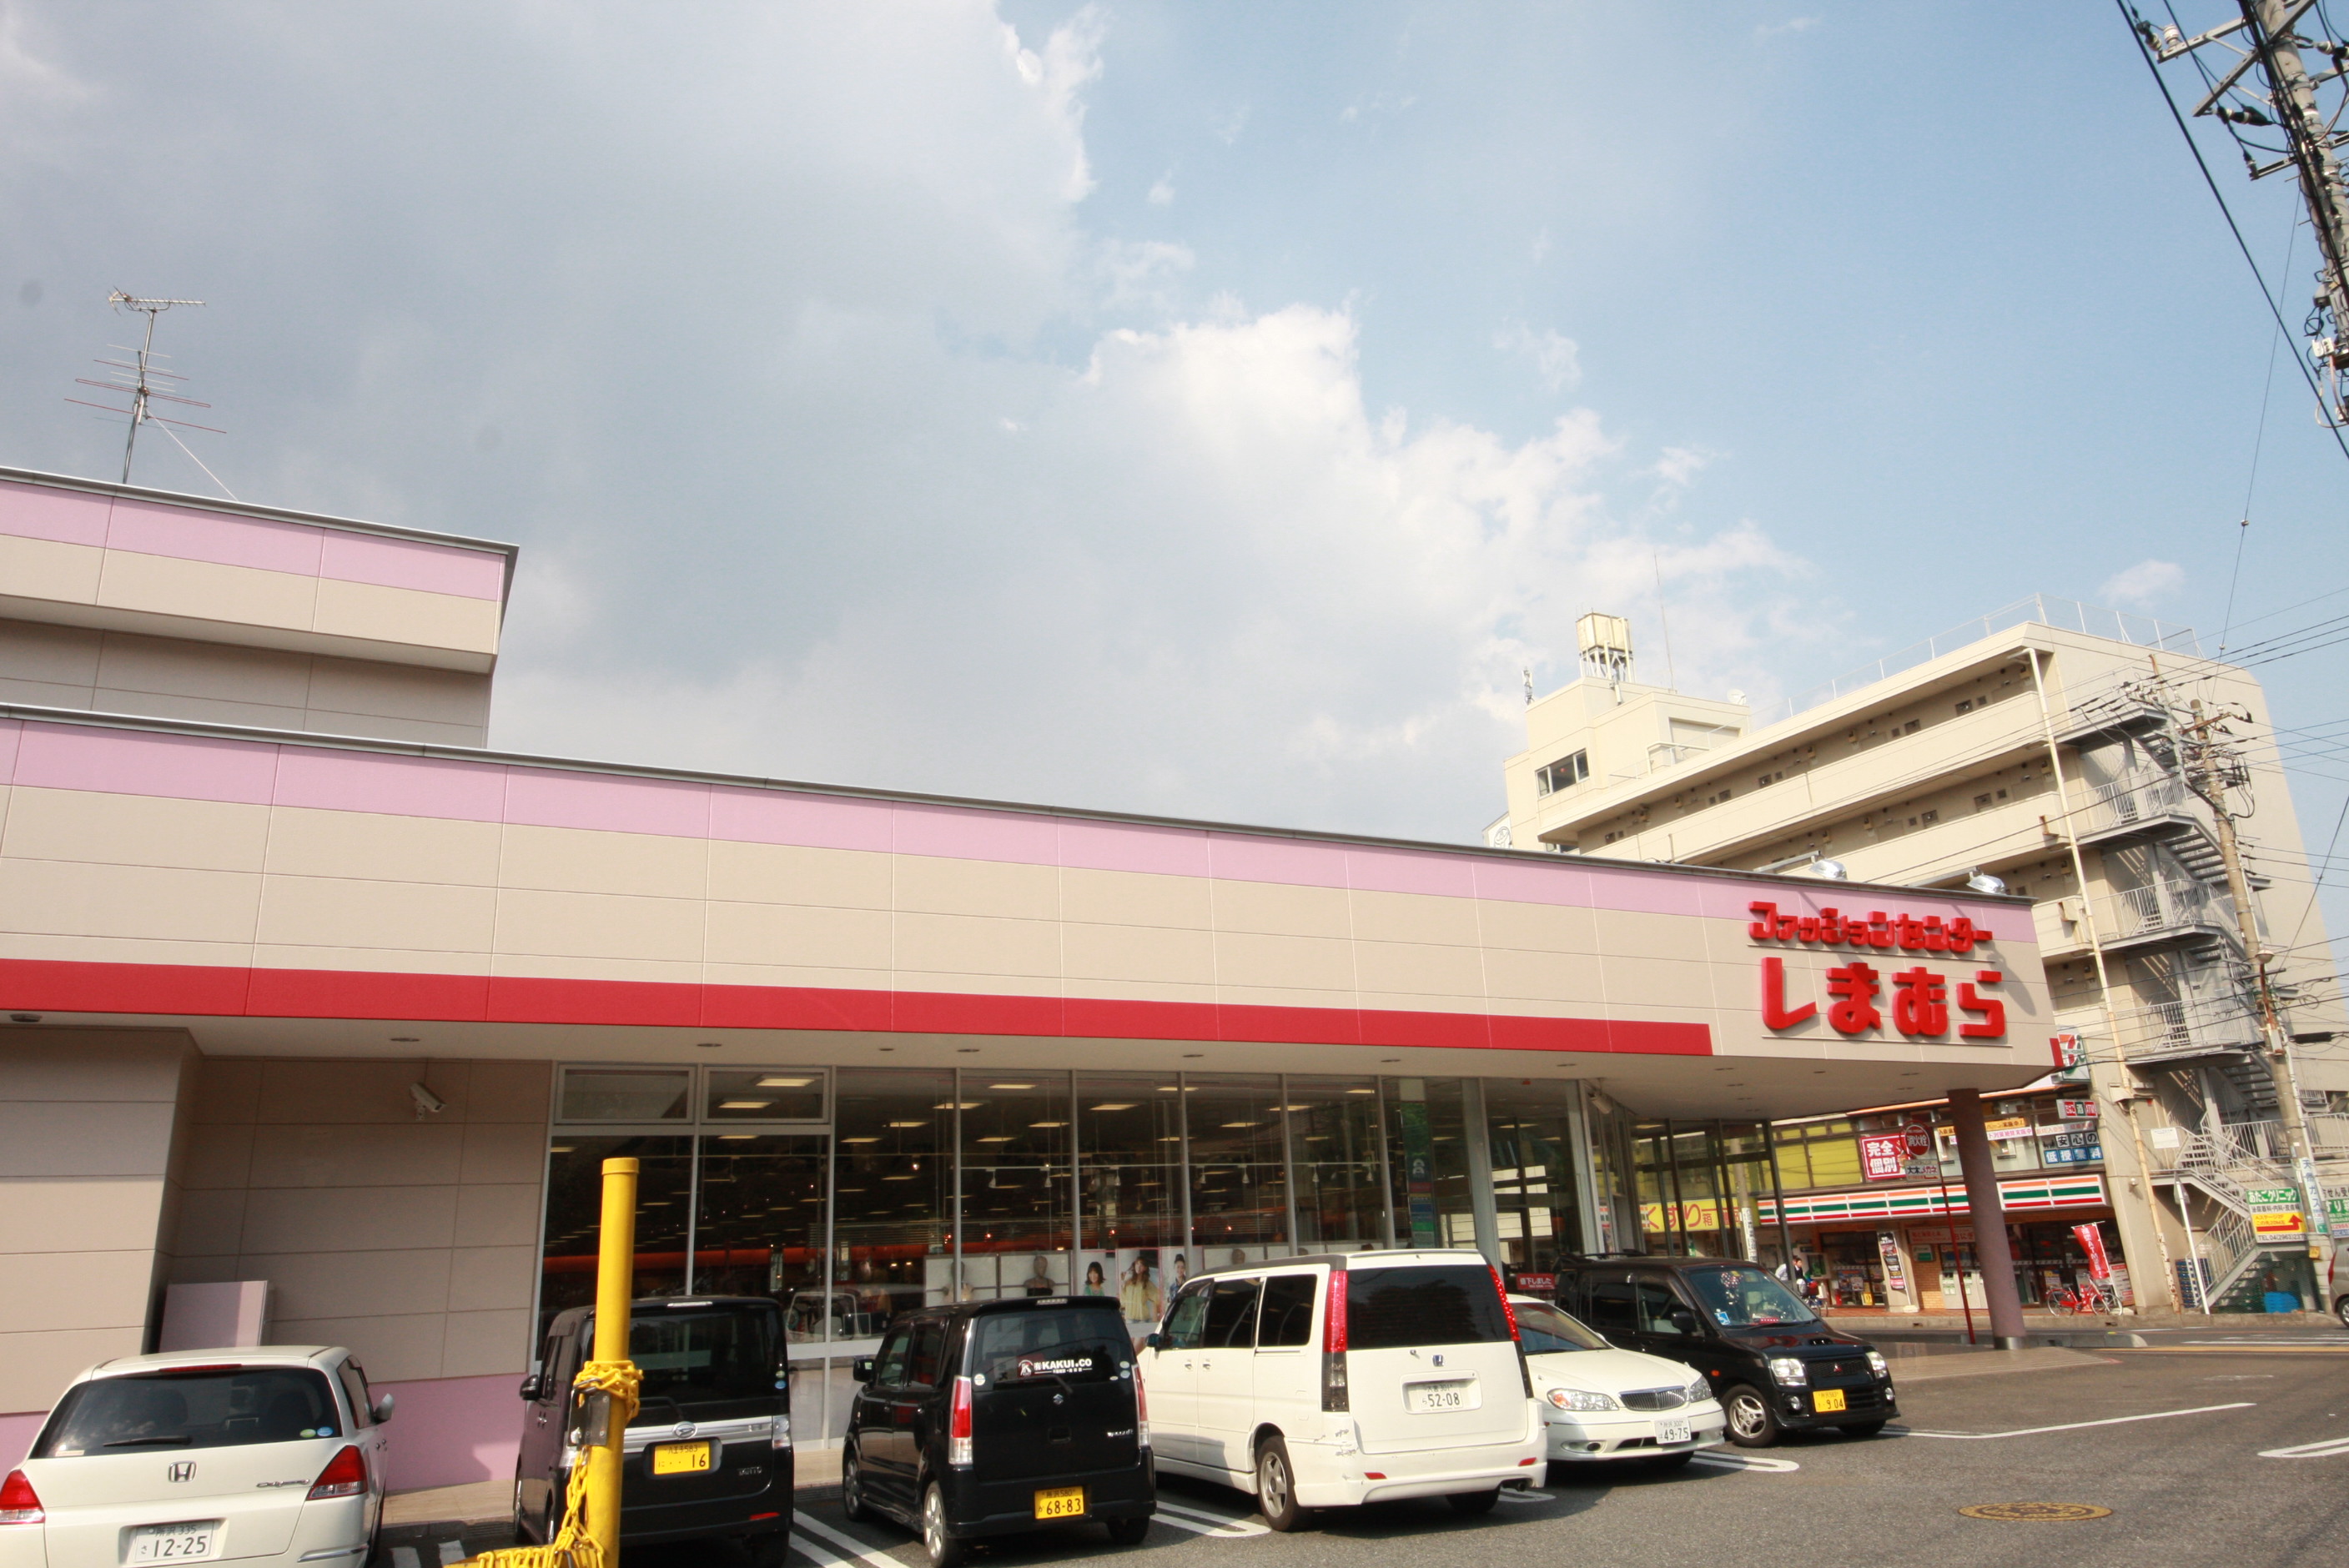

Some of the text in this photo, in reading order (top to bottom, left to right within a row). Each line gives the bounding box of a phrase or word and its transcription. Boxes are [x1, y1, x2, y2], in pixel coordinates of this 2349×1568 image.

[1748, 901, 1993, 952] ファッションセンター
[1761, 957, 2005, 1038] しまむら
[1907, 1134, 1928, 1147] 消火栓
[2057, 1133, 2097, 1146] 安心の
[1867, 1140, 1894, 1158] 完全
[2046, 1147, 2101, 1163] 低授業料
[1869, 1157, 1898, 1174] 個別
[2248, 1188, 2297, 1203] あたごクリニック
[1427, 1392, 1461, 1407] 52-08
[1664, 1427, 1689, 1441] 49-75
[1046, 1498, 1081, 1515] 68-83
[153, 1535, 208, 1558] 12-25
